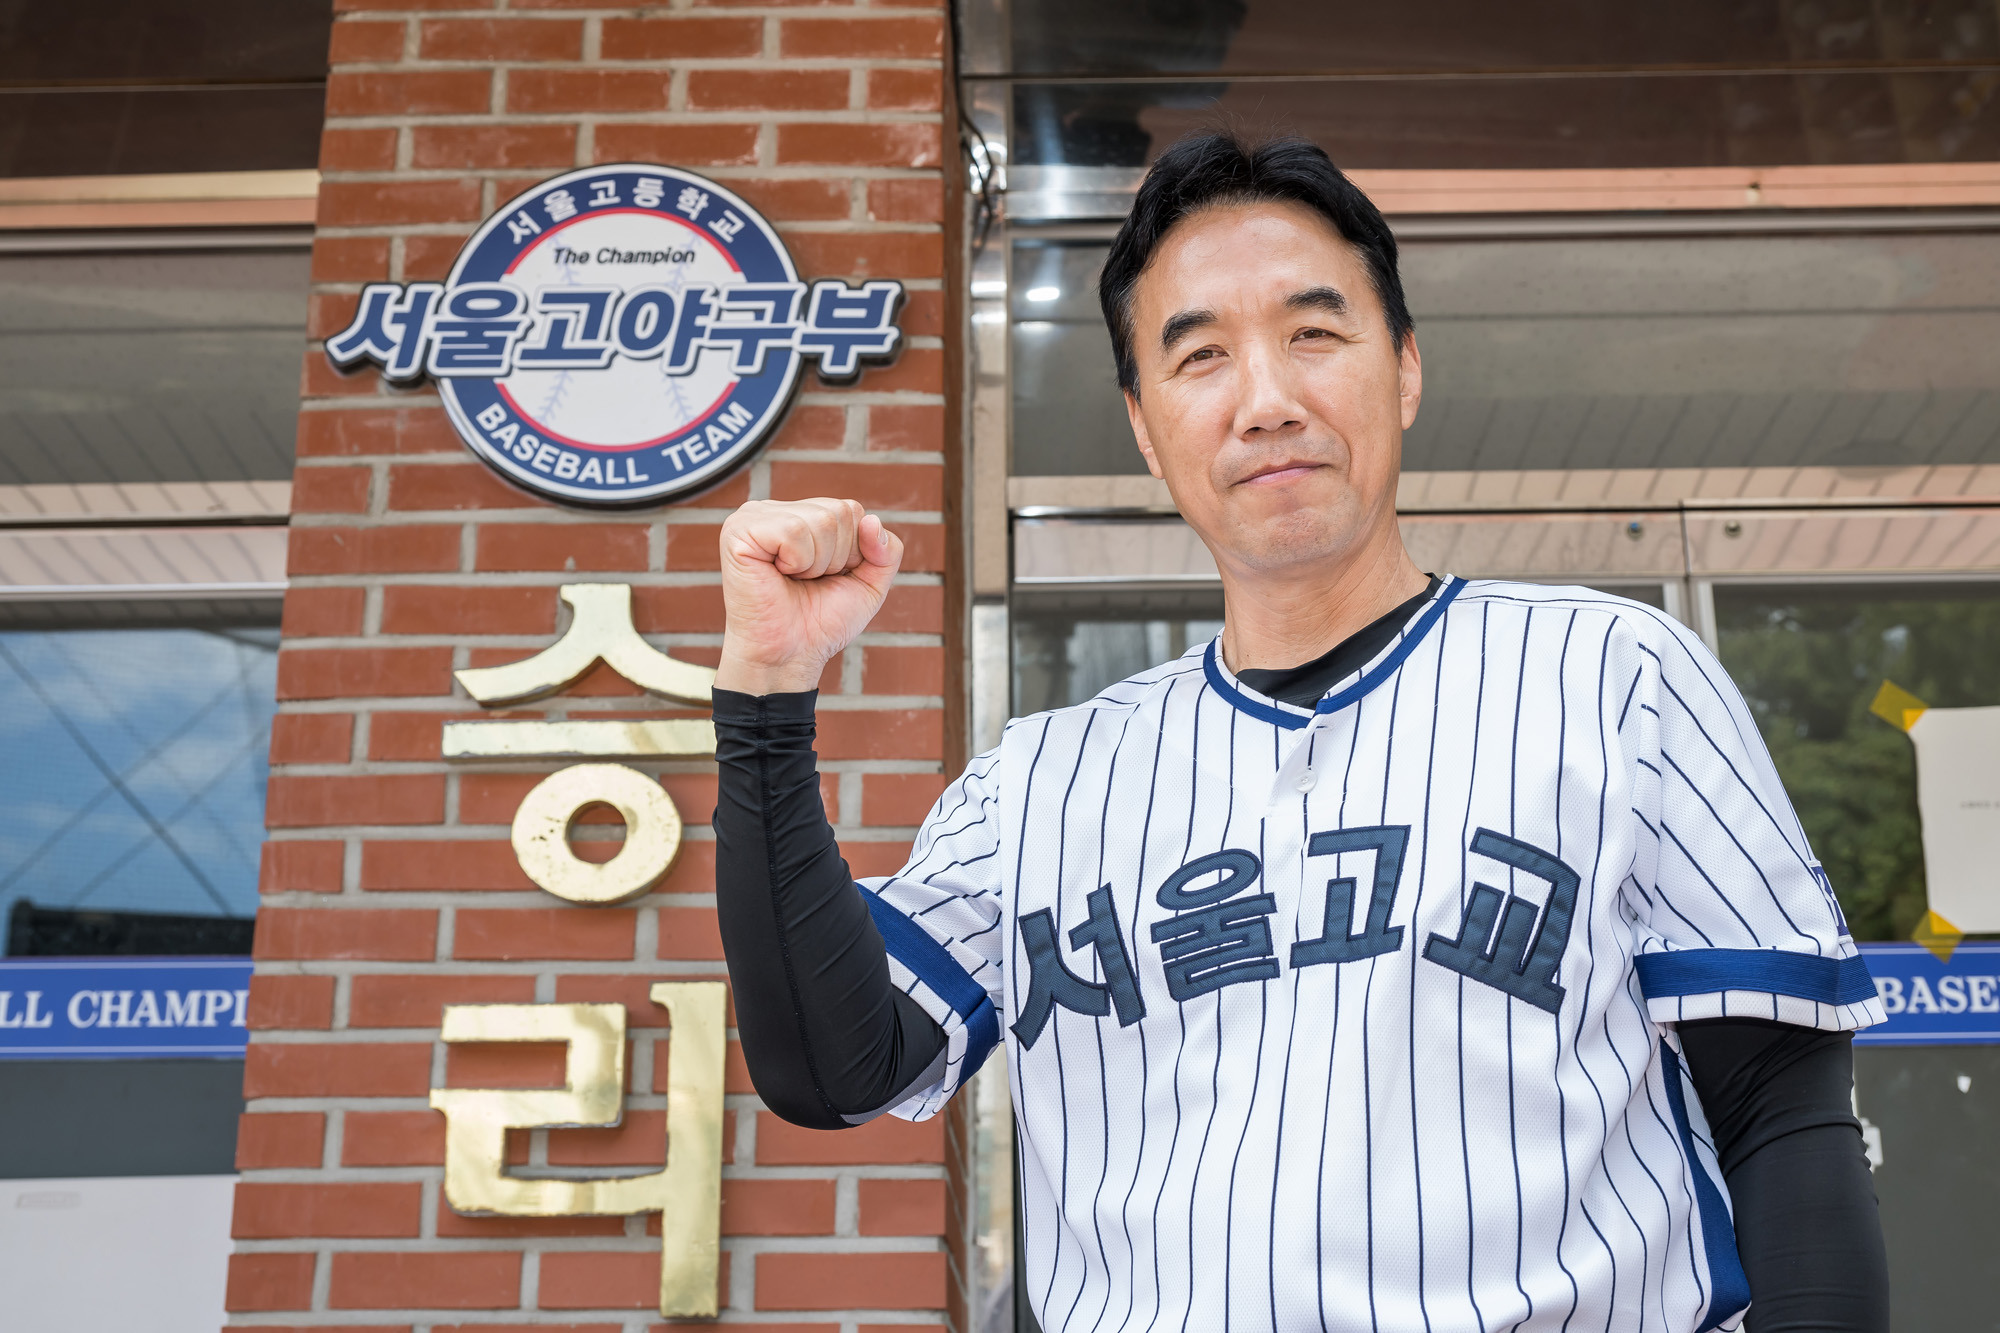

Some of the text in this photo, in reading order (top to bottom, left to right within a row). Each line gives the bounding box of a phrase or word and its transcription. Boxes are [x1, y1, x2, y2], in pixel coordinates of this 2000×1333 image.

[506, 177, 746, 243] 서울고등학교
[553, 246, 696, 265] The Champion
[326, 281, 903, 376] 서울고야구부
[475, 401, 755, 485] BASEBALL TEAM
[429, 582, 727, 1320] 승리
[1009, 824, 1581, 1052] 서울고교
[67, 989, 250, 1029] CHAMPI
[1873, 975, 2000, 1014] BASE
